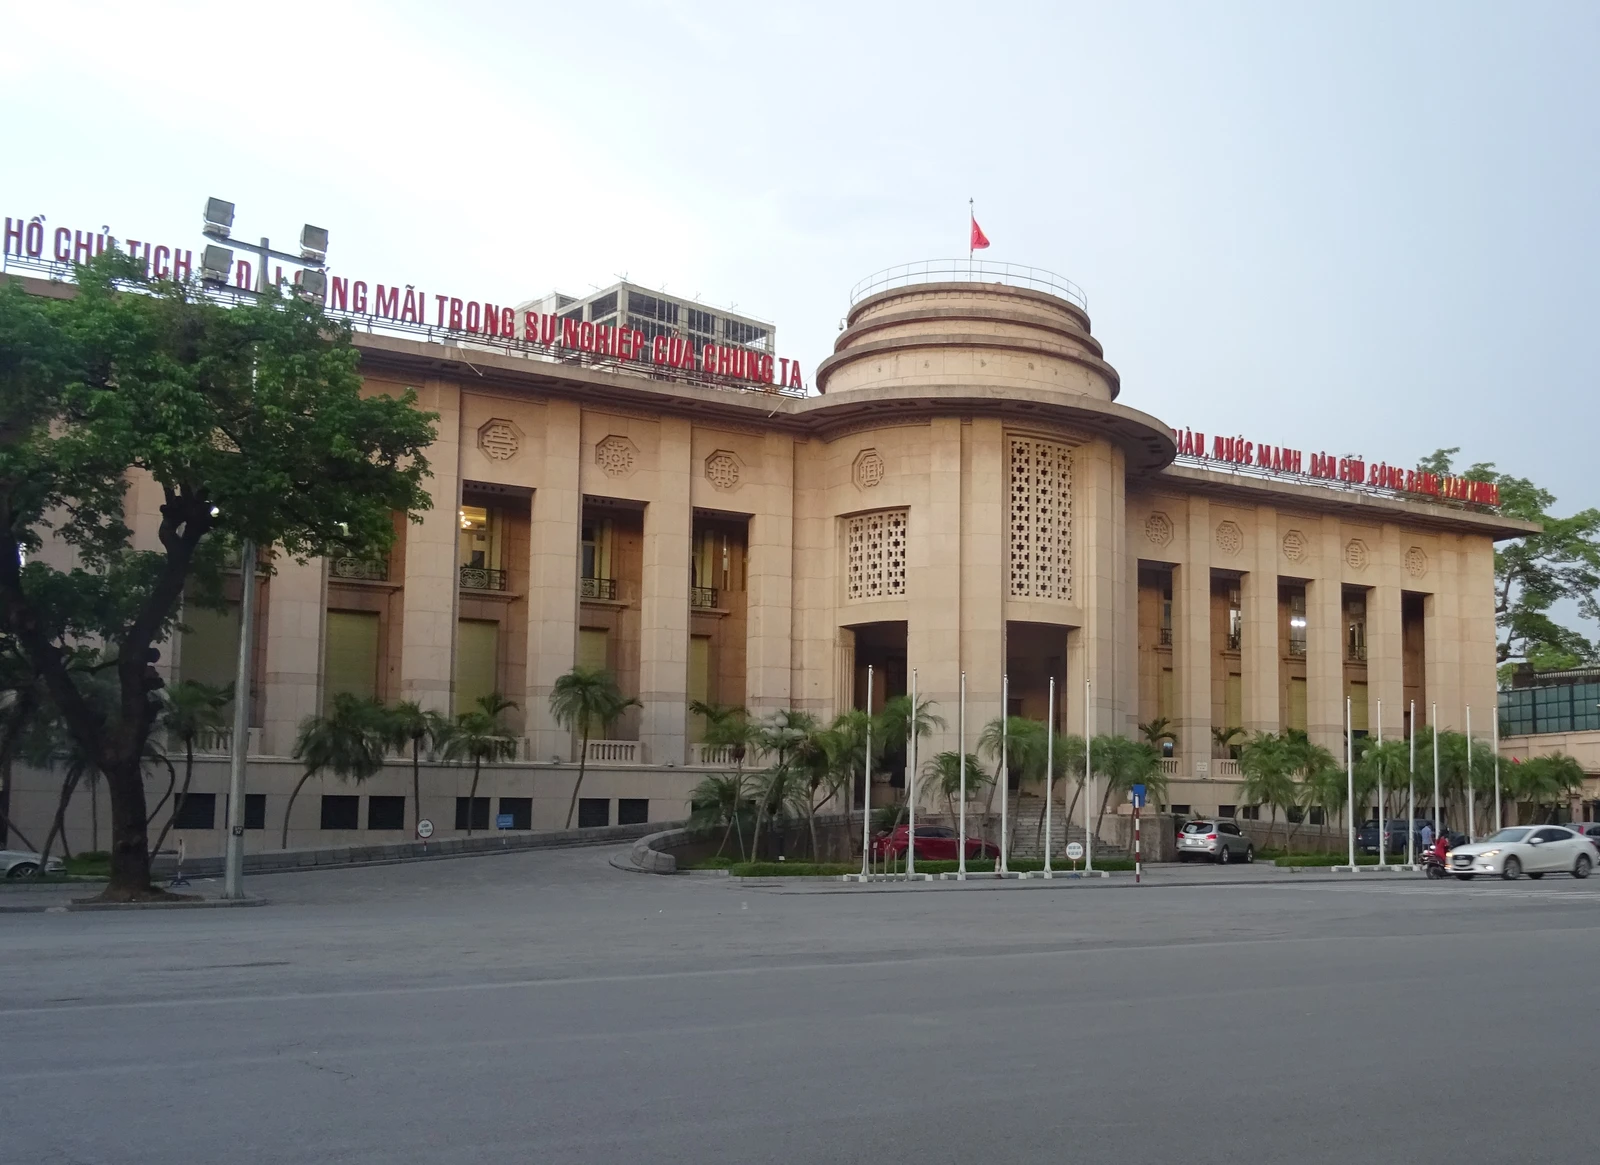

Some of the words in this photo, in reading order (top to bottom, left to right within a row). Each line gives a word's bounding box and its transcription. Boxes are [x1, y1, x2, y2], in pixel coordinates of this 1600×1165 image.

[4, 214, 46, 257] HỒ
[236, 259, 282, 294] ĐI
[373, 284, 425, 325] MÃI
[435, 294, 515, 338] TRONG
[525, 310, 558, 349] SỰ
[561, 318, 645, 363] NGHIỆP
[653, 329, 696, 370] CỦA
[703, 344, 774, 384] CHÚNG
[779, 357, 802, 389] TA
[1214, 434, 1254, 465] NƯỚC
[1311, 451, 1336, 480] DÂN
[1371, 461, 1404, 490] CÔNG
